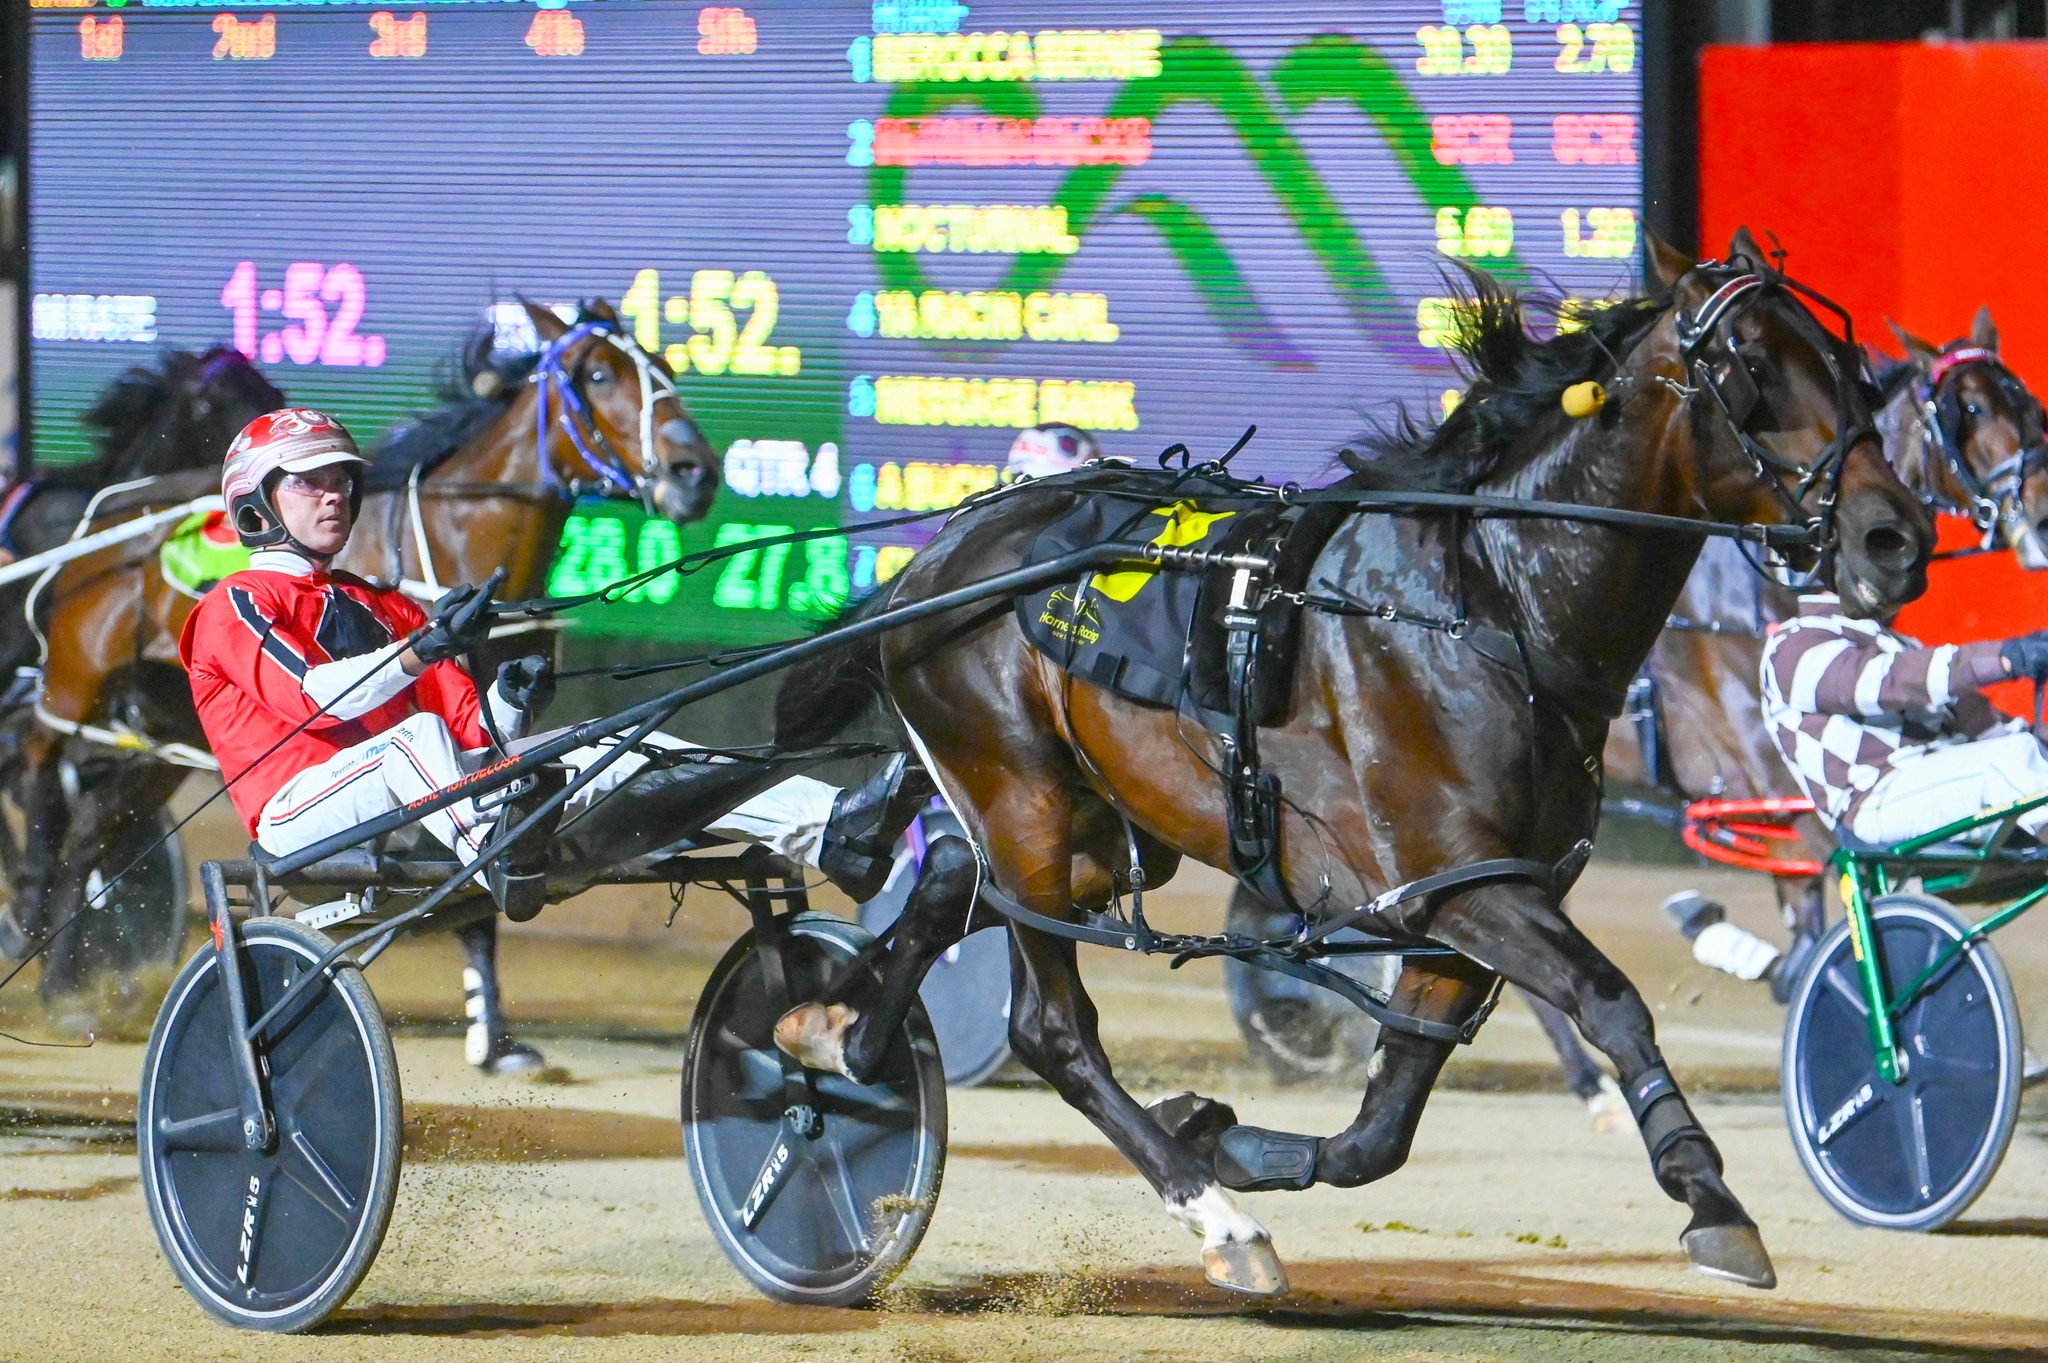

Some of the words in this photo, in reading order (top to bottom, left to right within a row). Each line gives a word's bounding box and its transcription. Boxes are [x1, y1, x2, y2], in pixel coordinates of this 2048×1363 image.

[212, 14, 275, 59] 2nd
[369, 12, 426, 57] 3rd
[525, 10, 585, 56] 4th
[697, 8, 758, 54] 5th
[847, 36, 872, 82] 1
[846, 119, 874, 166] 2
[1039, 611, 1078, 635] Harnes
[743, 1167, 775, 1227] LZR
[237, 1207, 255, 1284] LZR
